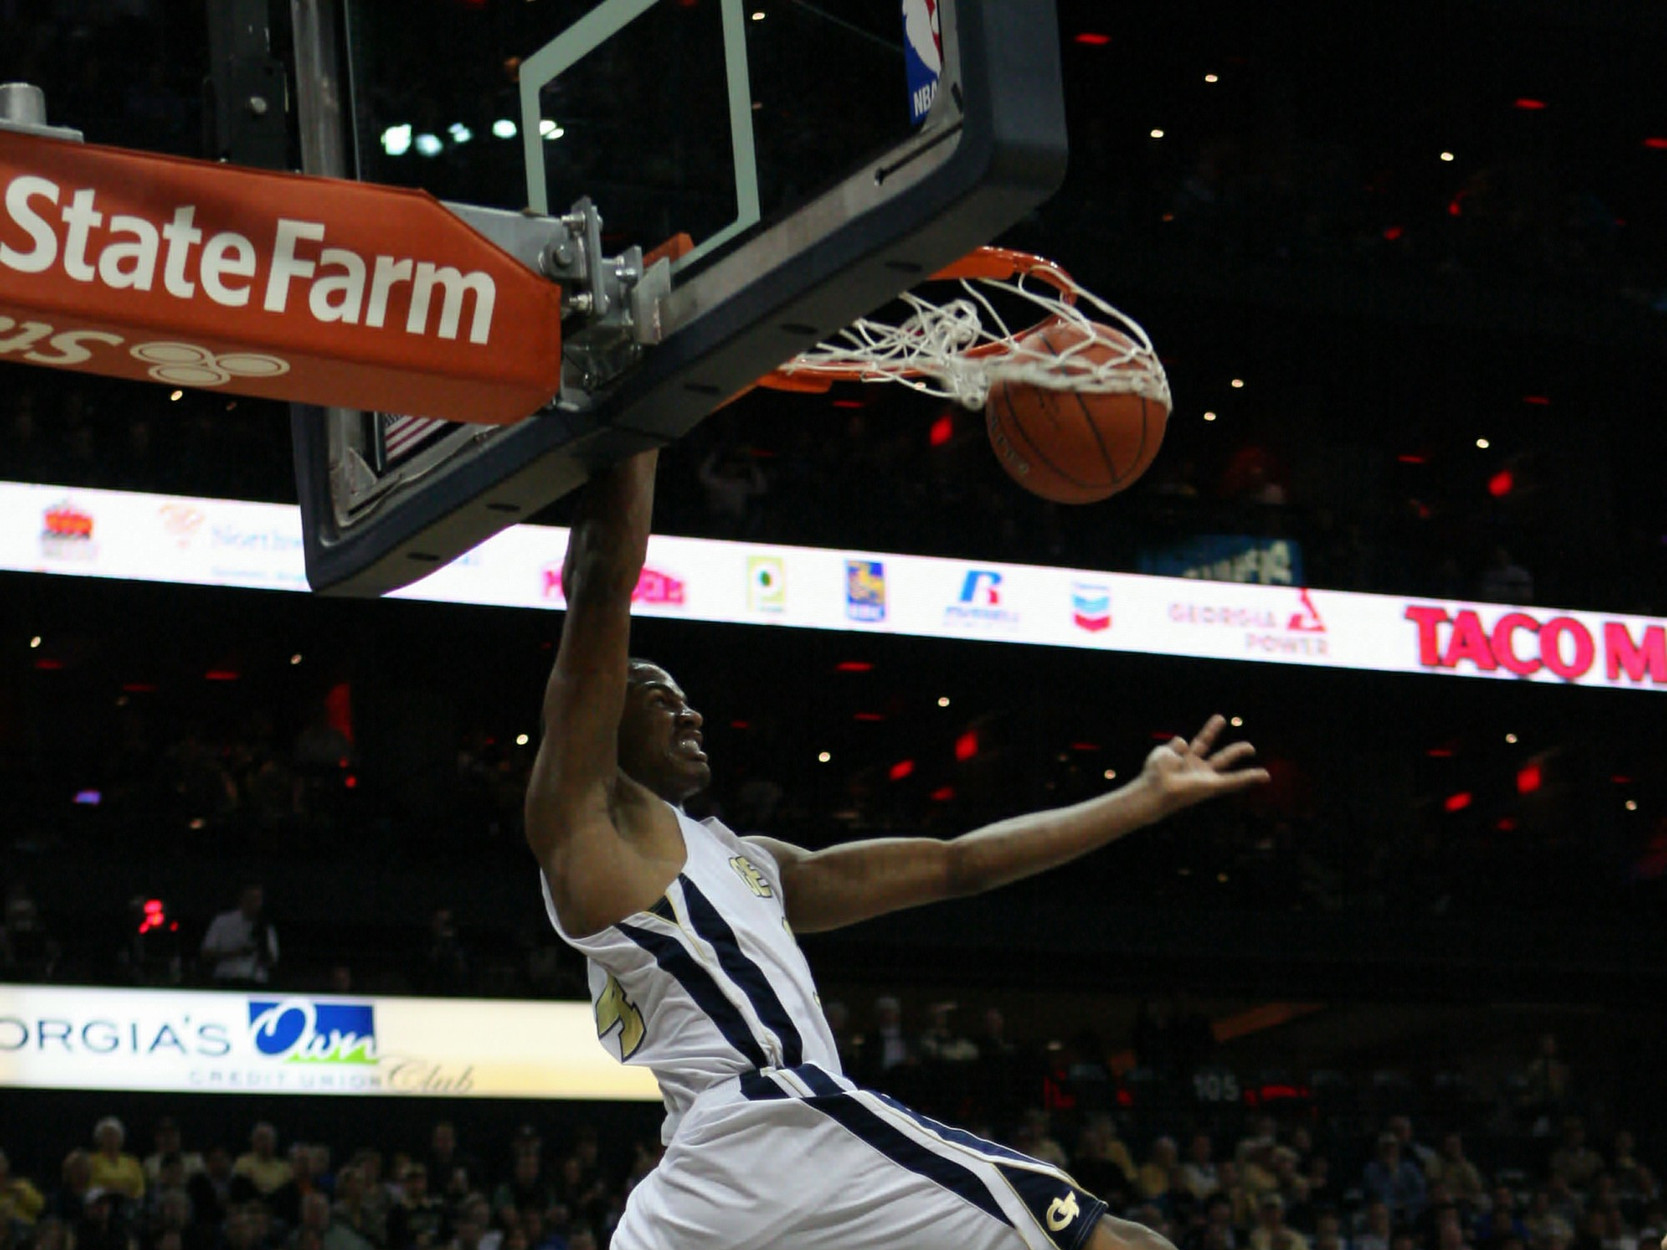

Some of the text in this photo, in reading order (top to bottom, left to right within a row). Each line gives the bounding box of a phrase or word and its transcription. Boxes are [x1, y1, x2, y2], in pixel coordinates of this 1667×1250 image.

[1168, 602, 1277, 629] GEORGIA
[1245, 632, 1330, 656] POWER
[1405, 605, 1595, 680] TACO
[250, 998, 378, 1060] Own
[190, 1069, 382, 1087] CREDIT UNION
[385, 1058, 474, 1094] Club
